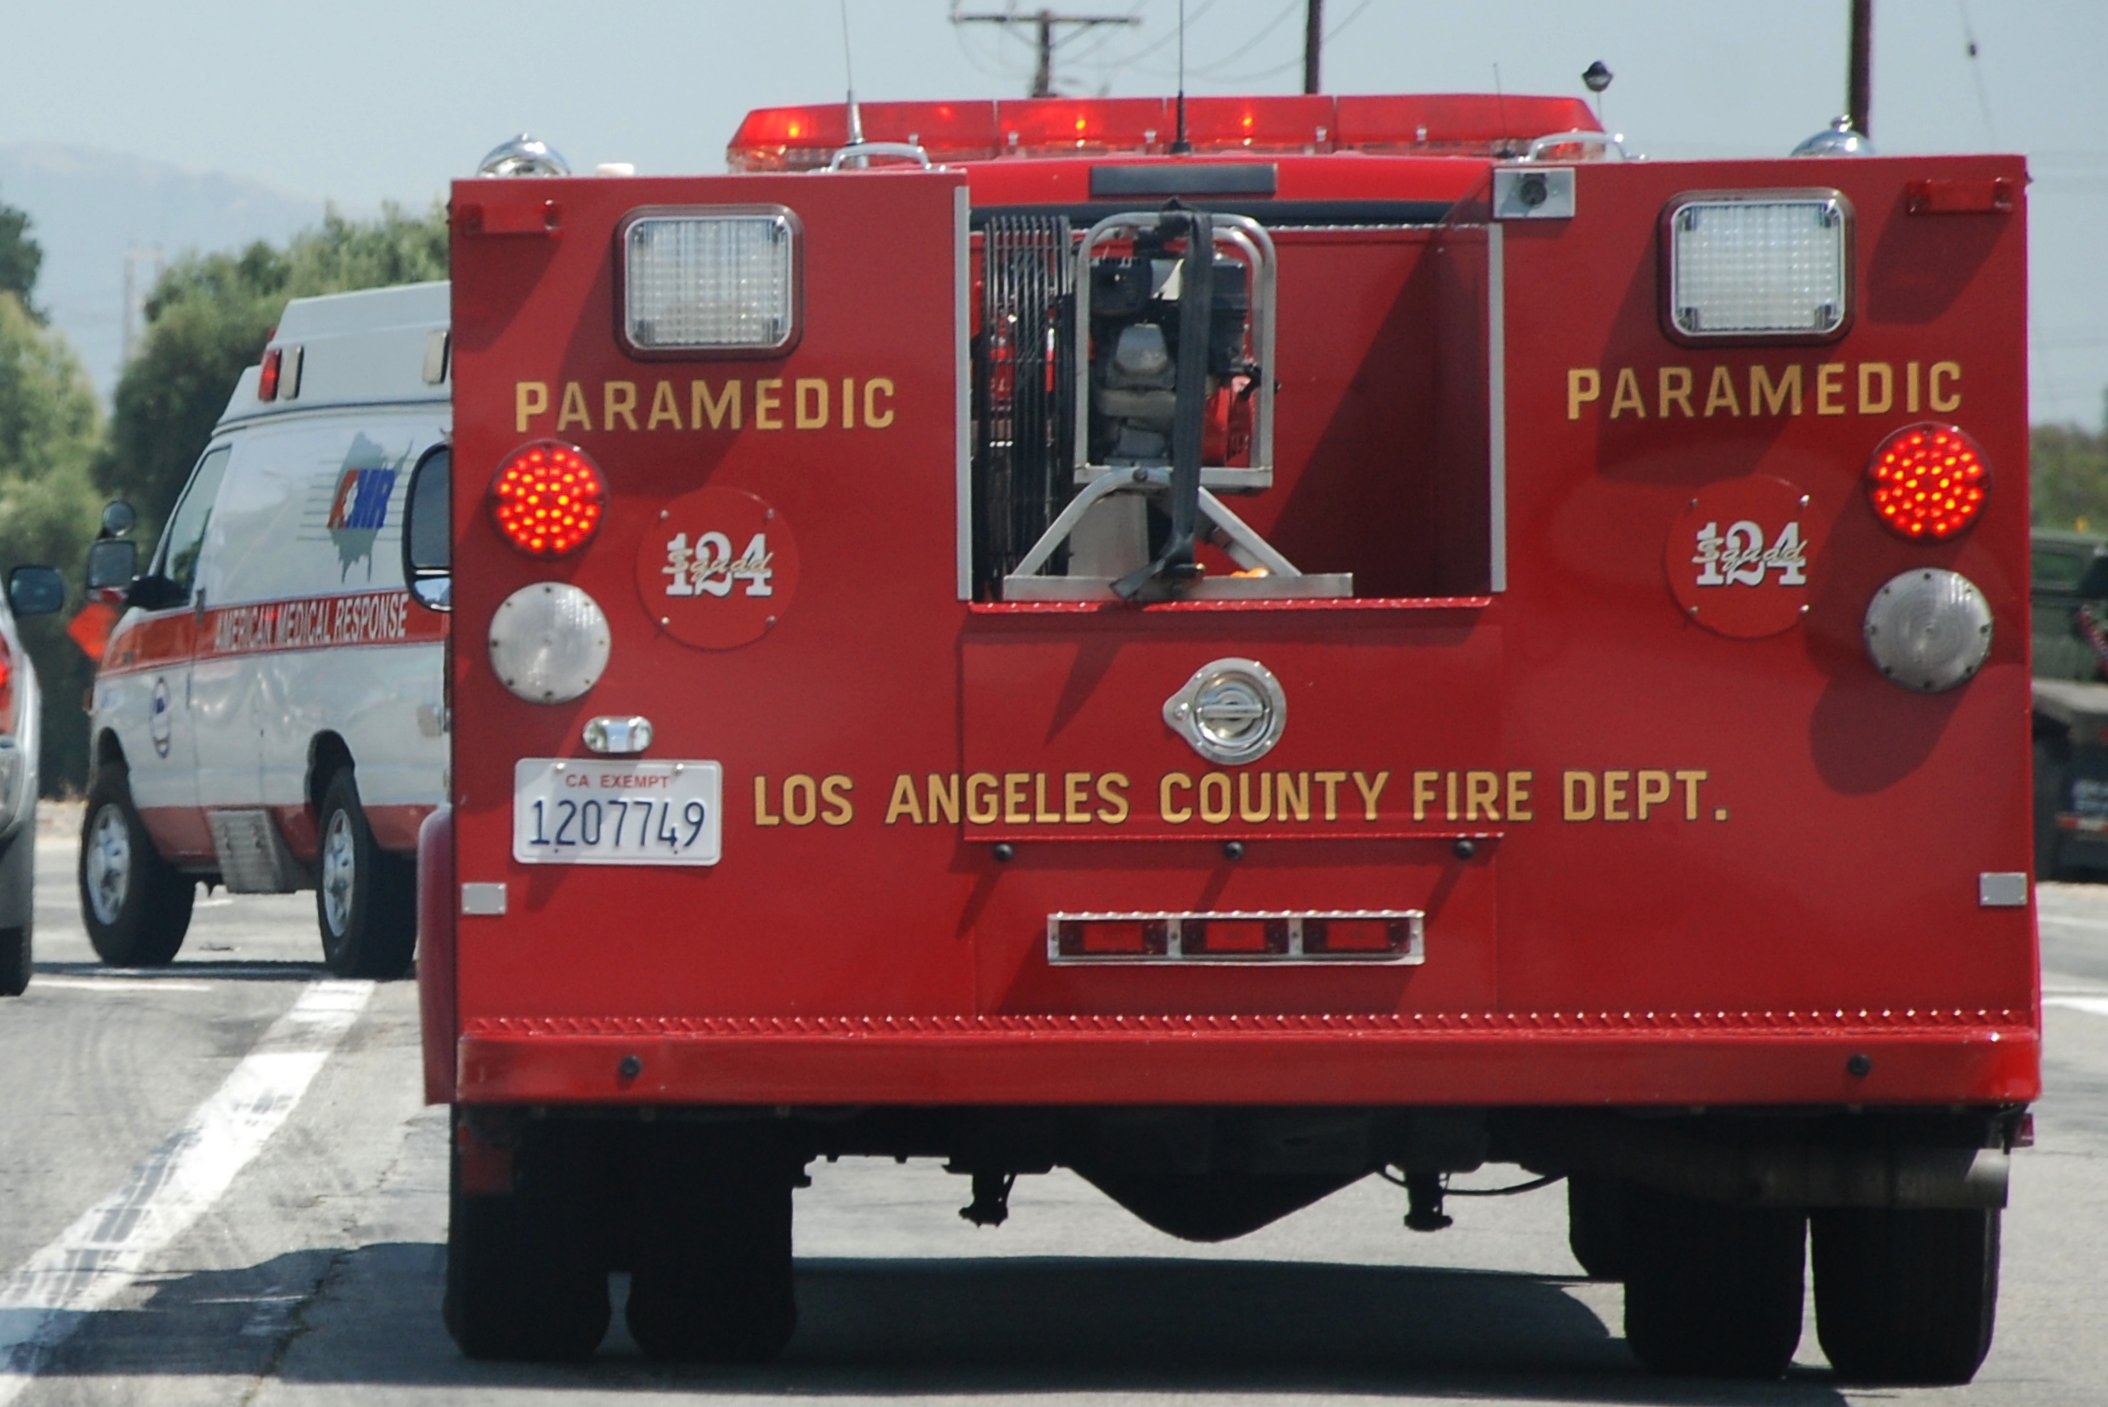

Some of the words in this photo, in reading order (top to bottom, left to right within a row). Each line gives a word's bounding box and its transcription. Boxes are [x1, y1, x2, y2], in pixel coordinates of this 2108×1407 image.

[515, 377, 895, 432] PARAMEDIC
[1567, 360, 1963, 420] PARAMEDIC
[327, 468, 396, 529] AMR
[662, 548, 774, 583] Squad
[665, 531, 773, 597] 124
[1691, 537, 1808, 573] Squad
[1696, 520, 1806, 586] 124
[214, 605, 275, 652] AMERICAN
[275, 600, 331, 647] MEDICAL
[334, 593, 410, 641] RESPONSE
[565, 774, 590, 788] CA
[600, 774, 671, 789] EXEMPT
[754, 774, 854, 826] LOS
[885, 772, 1130, 825] ANGELES
[1160, 771, 1390, 824] COUNTY
[1412, 771, 1533, 822] FIRE
[1563, 770, 1728, 822] DEPT.
[530, 799, 706, 848] 1207749
